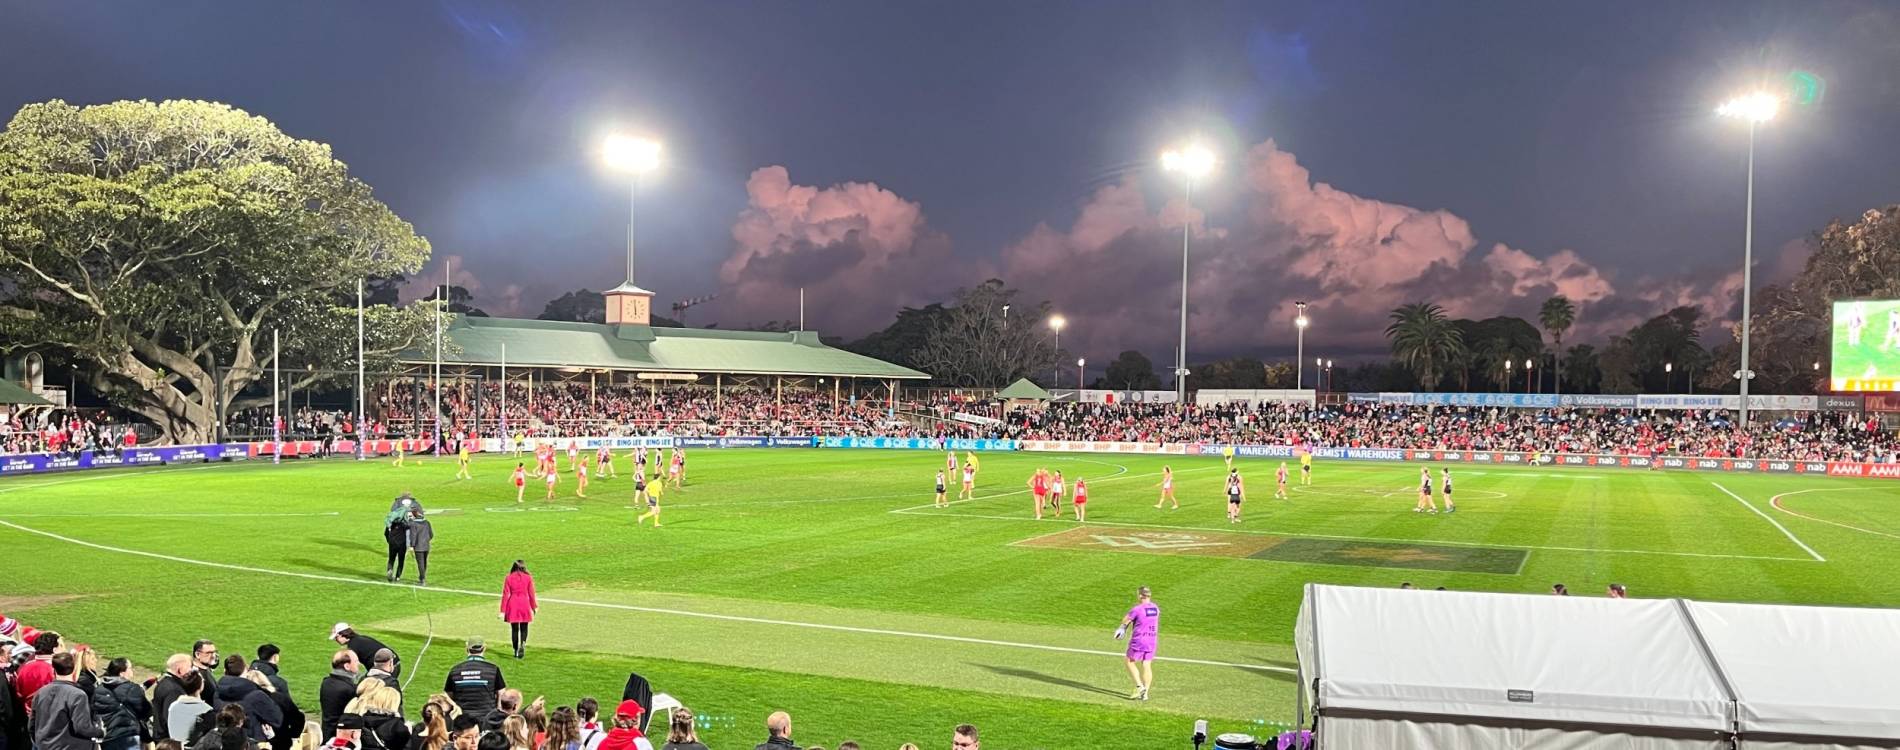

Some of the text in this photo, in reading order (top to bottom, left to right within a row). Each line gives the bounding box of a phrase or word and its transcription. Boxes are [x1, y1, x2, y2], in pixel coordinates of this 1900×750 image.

[1576, 396, 1634, 406] Volkswagen
[1683, 398, 1706, 406] BING
[1826, 399, 1855, 407] dexus
[684, 438, 716, 446] Volkswagen
[728, 438, 762, 446] Volkswagen
[776, 438, 810, 446] Volkswagen
[1142, 444, 1158, 452] BHP
[1201, 446, 1291, 456] CHEMT WAREHOUSE
[1311, 448, 1402, 459] HEMIST WAREHOUSE
[1445, 452, 1460, 460] nab
[1599, 456, 1615, 464] nab
[1665, 458, 1682, 466] nab
[1700, 460, 1717, 468] nab
[1735, 461, 1752, 469] nab
[1770, 462, 1789, 470] nab
[1807, 463, 1826, 471] nab
[1832, 464, 1862, 474] AAMI
[1869, 466, 1900, 476] AAMI
